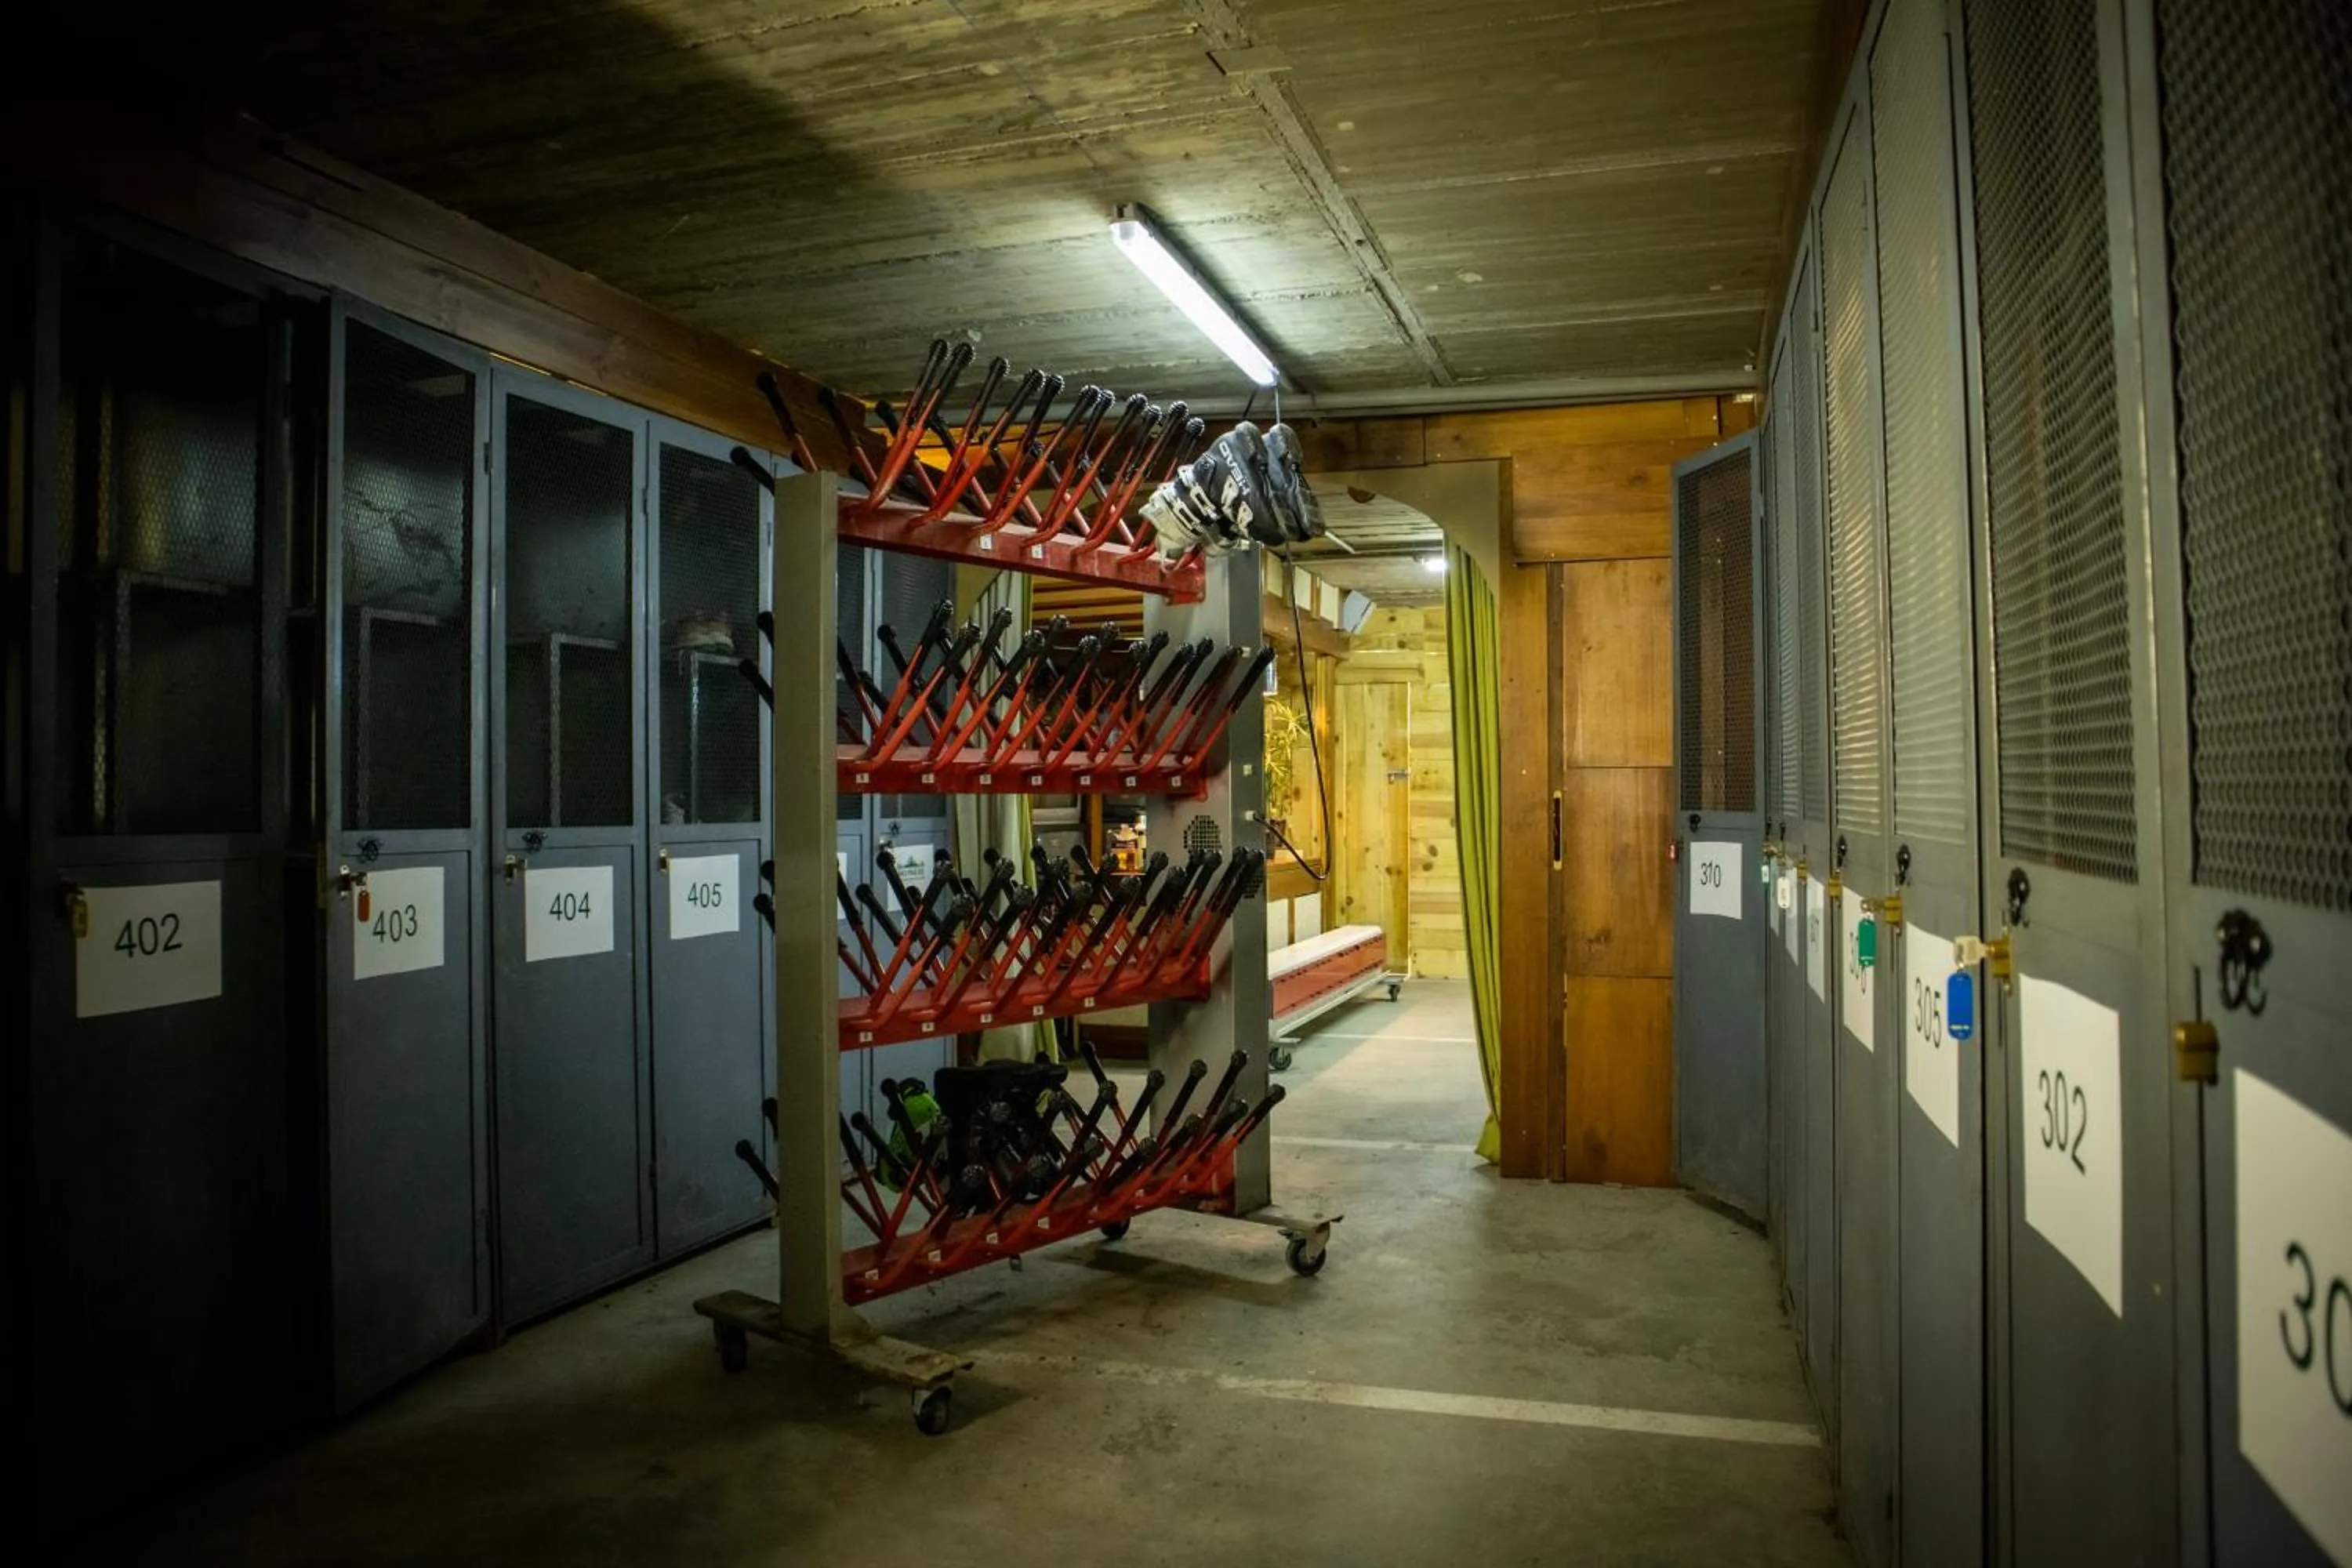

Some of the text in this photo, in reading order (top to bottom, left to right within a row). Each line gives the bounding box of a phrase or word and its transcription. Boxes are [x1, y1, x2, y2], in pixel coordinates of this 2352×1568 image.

[1219, 441, 1250, 495] HEAD
[1700, 861, 1722, 887] 310
[549, 892, 591, 921] 404
[687, 882, 722, 909] 405
[114, 913, 183, 957] 402
[372, 904, 418, 942] 403
[1915, 977, 1942, 1048] 305
[2039, 1070, 2087, 1176] 302
